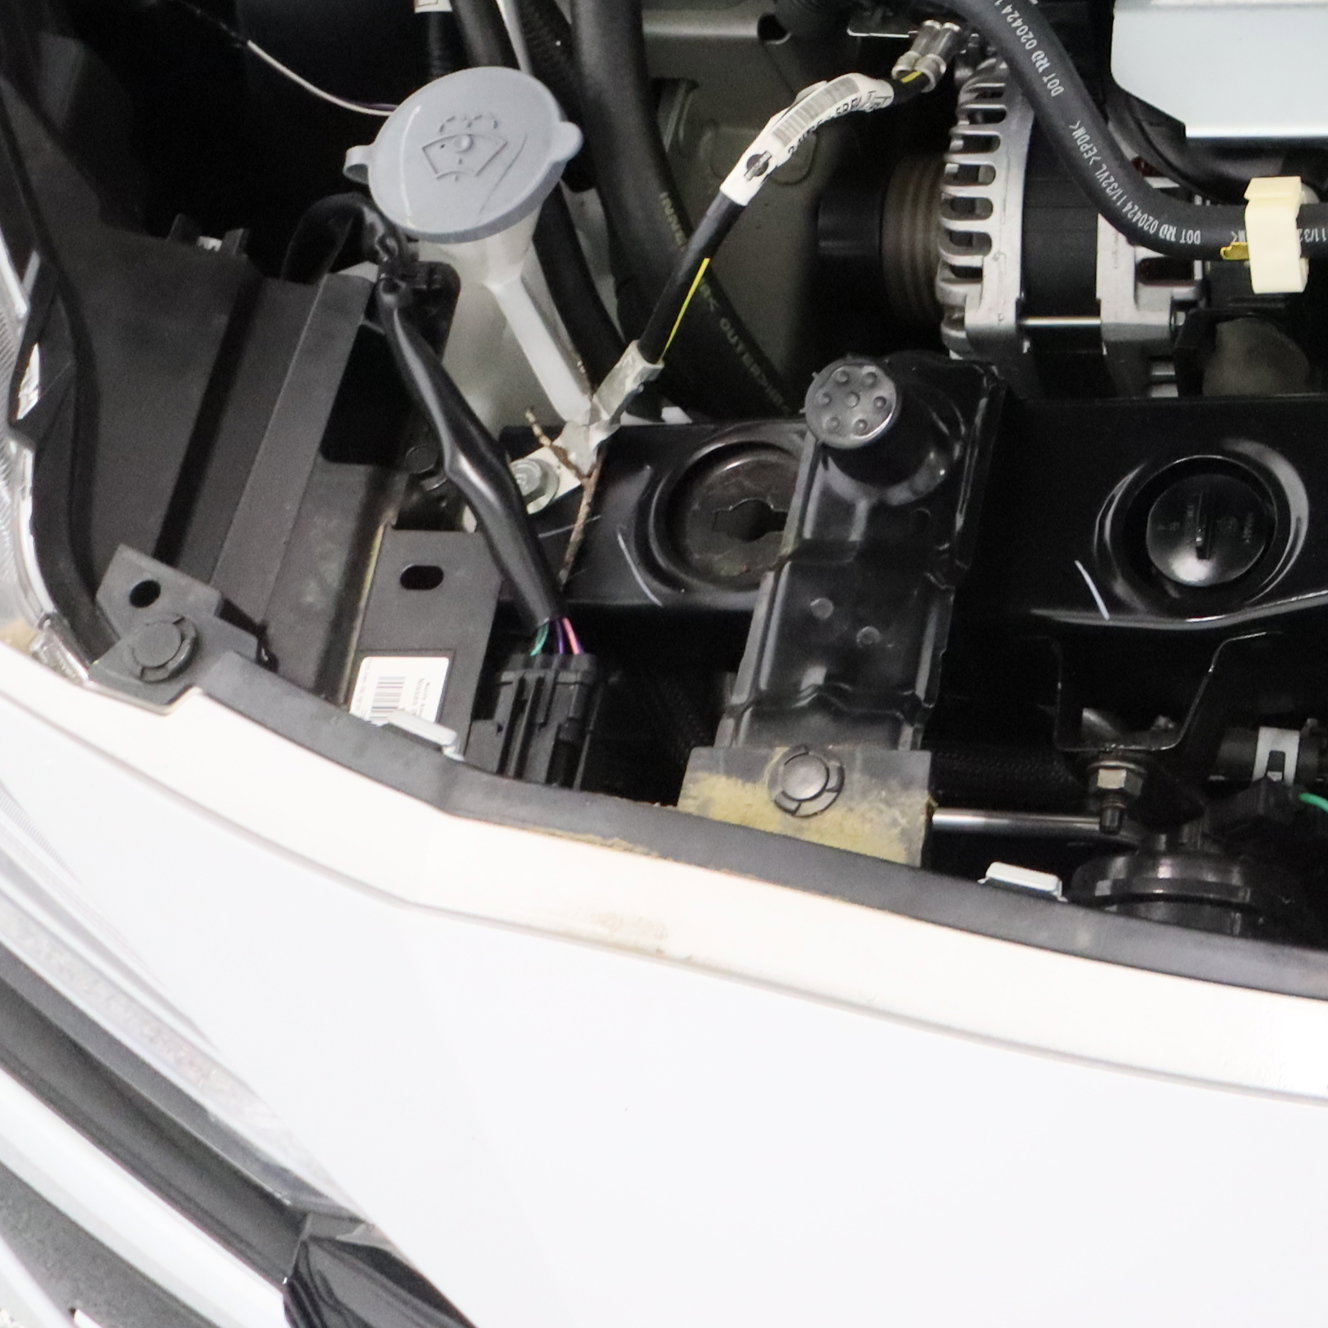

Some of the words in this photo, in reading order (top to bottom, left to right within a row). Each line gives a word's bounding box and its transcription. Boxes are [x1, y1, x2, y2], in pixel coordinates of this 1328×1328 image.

[1000, 3, 1038, 52] 020424
[1042, 71, 1065, 98] DOT
[1068, 119, 1102, 167] >EPDM<
[1121, 199, 1159, 235] 020424
[1179, 229, 1202, 245] DOT
